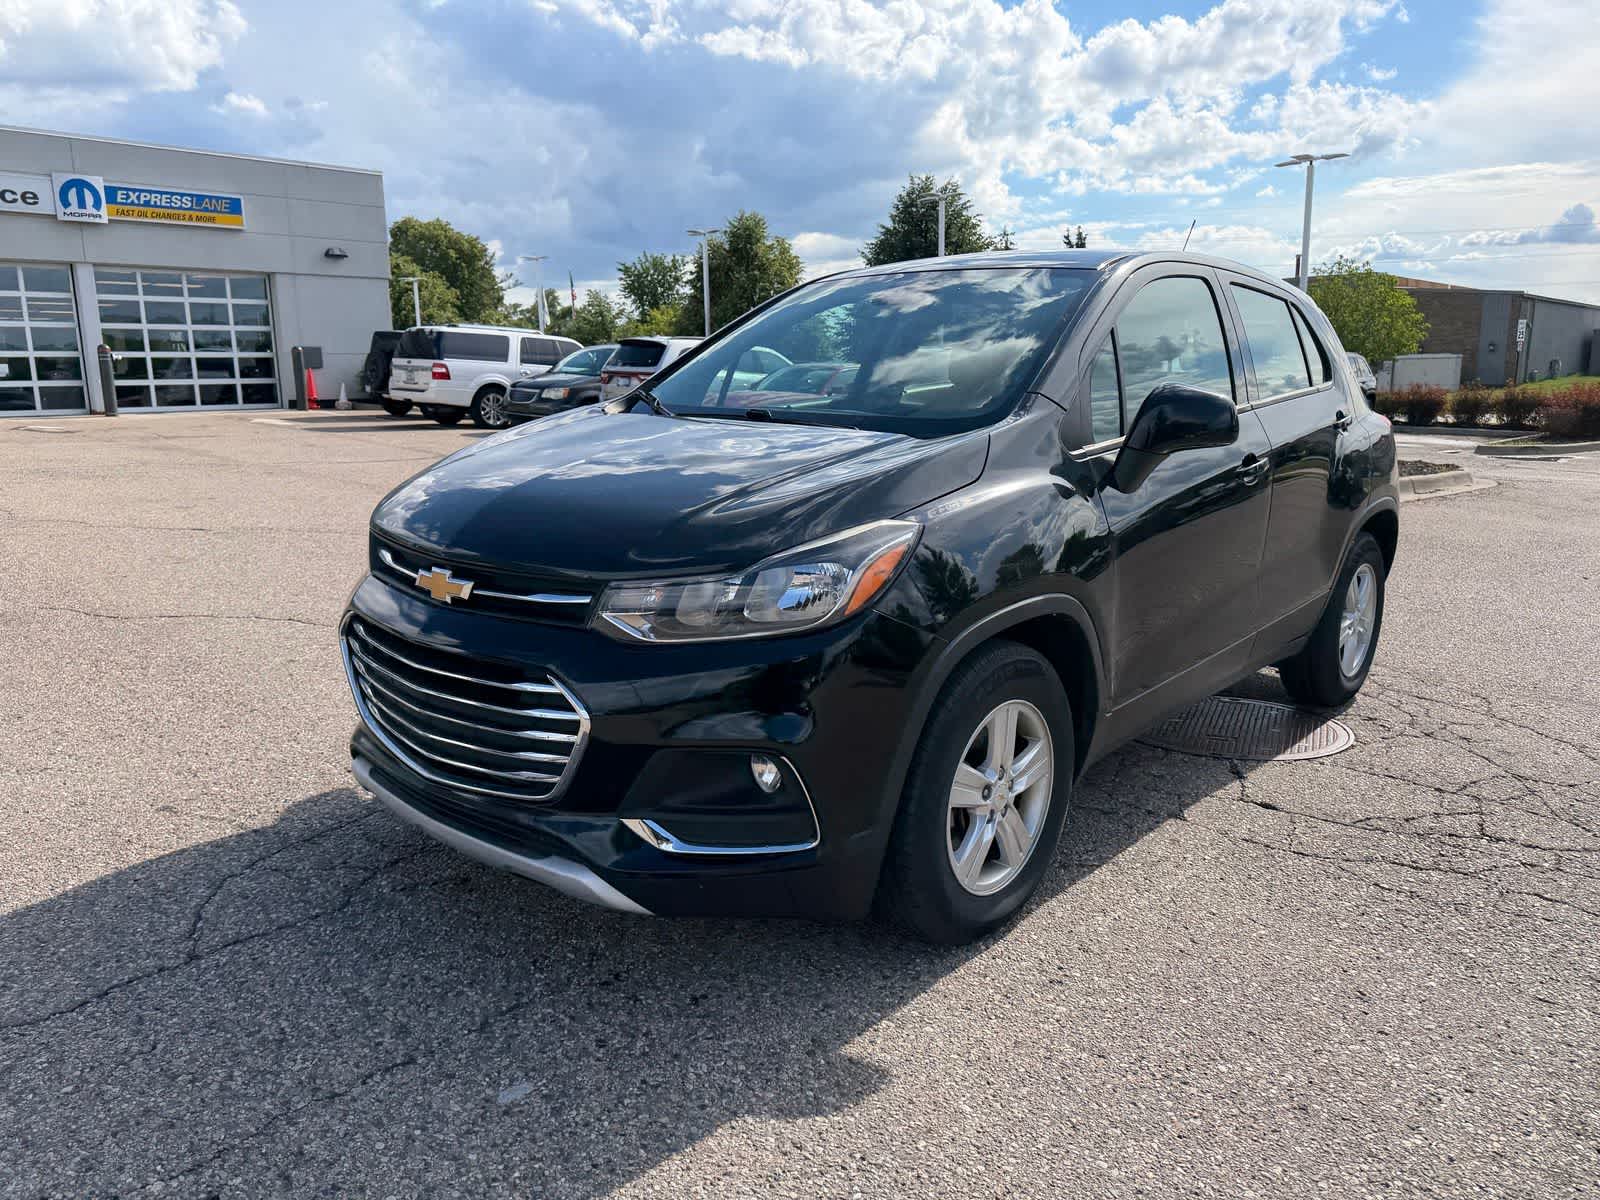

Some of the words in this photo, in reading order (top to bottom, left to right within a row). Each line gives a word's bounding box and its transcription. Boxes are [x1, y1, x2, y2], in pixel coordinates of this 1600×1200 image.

[63, 210, 102, 219] MOPAR
[115, 208, 134, 216] FAST
[137, 210, 148, 218] OIL
[151, 211, 185, 221] CHANGES
[187, 214, 194, 222] &
[195, 215, 217, 224] MORE
